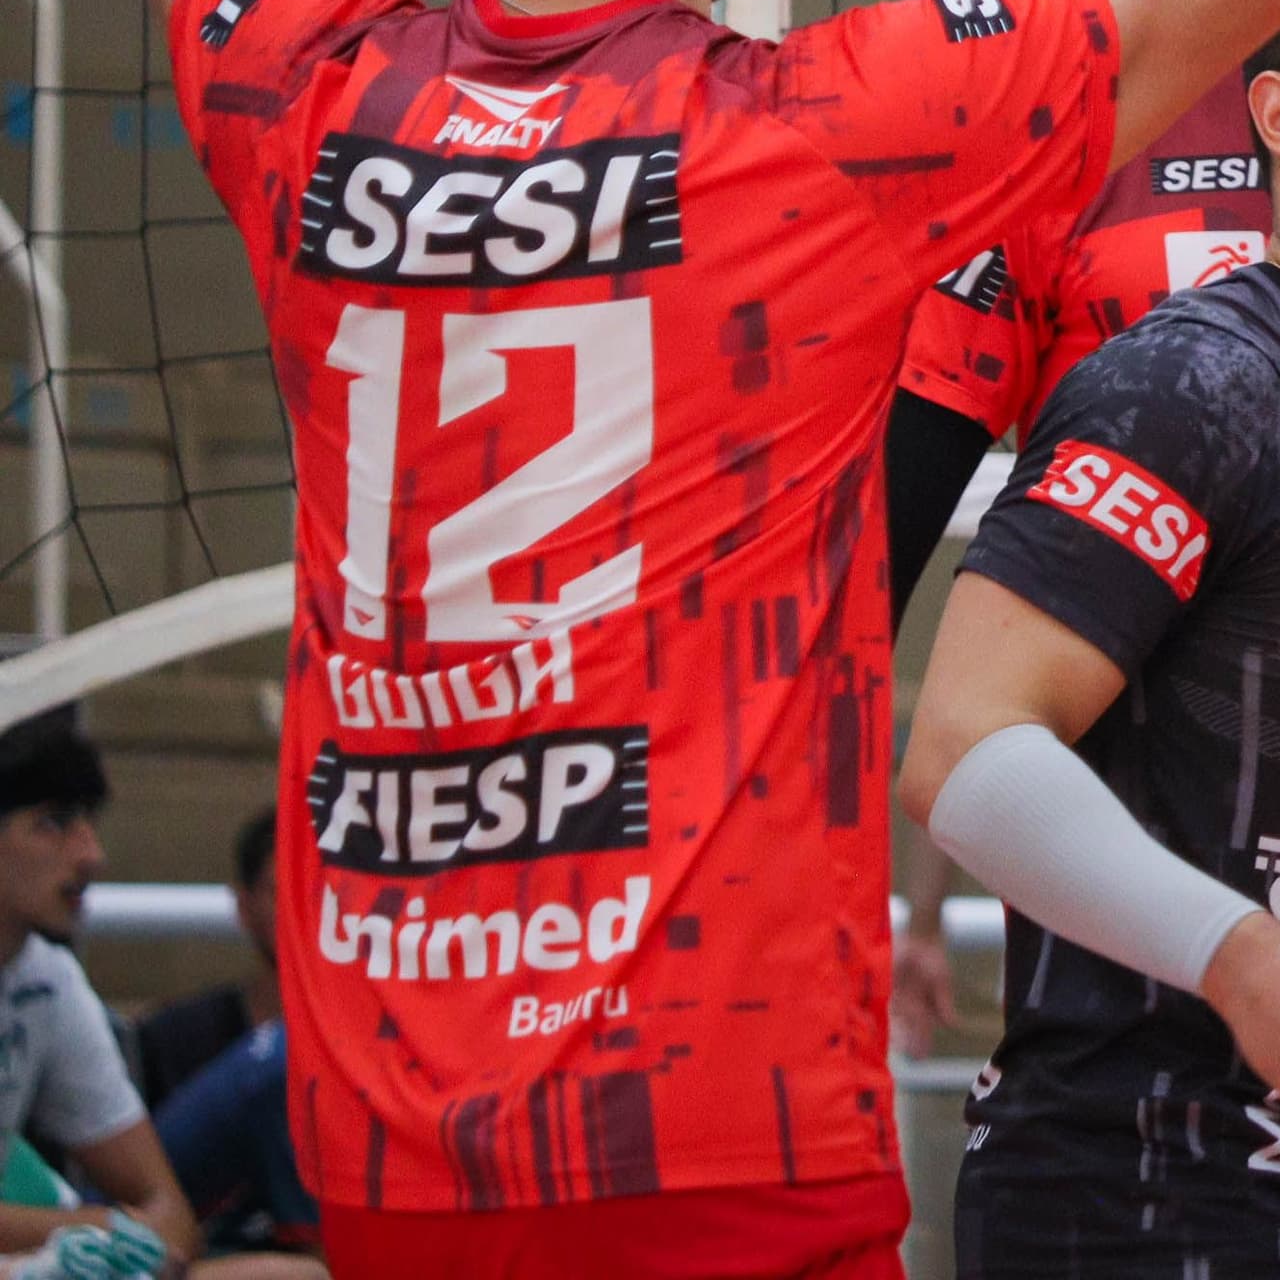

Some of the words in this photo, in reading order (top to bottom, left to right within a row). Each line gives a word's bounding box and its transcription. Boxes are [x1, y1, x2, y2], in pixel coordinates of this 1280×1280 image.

[433, 114, 563, 148] PNALTY
[1162, 157, 1259, 192] SESI
[326, 154, 647, 275] SESI
[324, 297, 652, 641] 12
[1049, 454, 1207, 578] SESI
[319, 743, 616, 863] FIESP
[319, 876, 650, 980] Unimed
[507, 983, 629, 1039] Bauru
